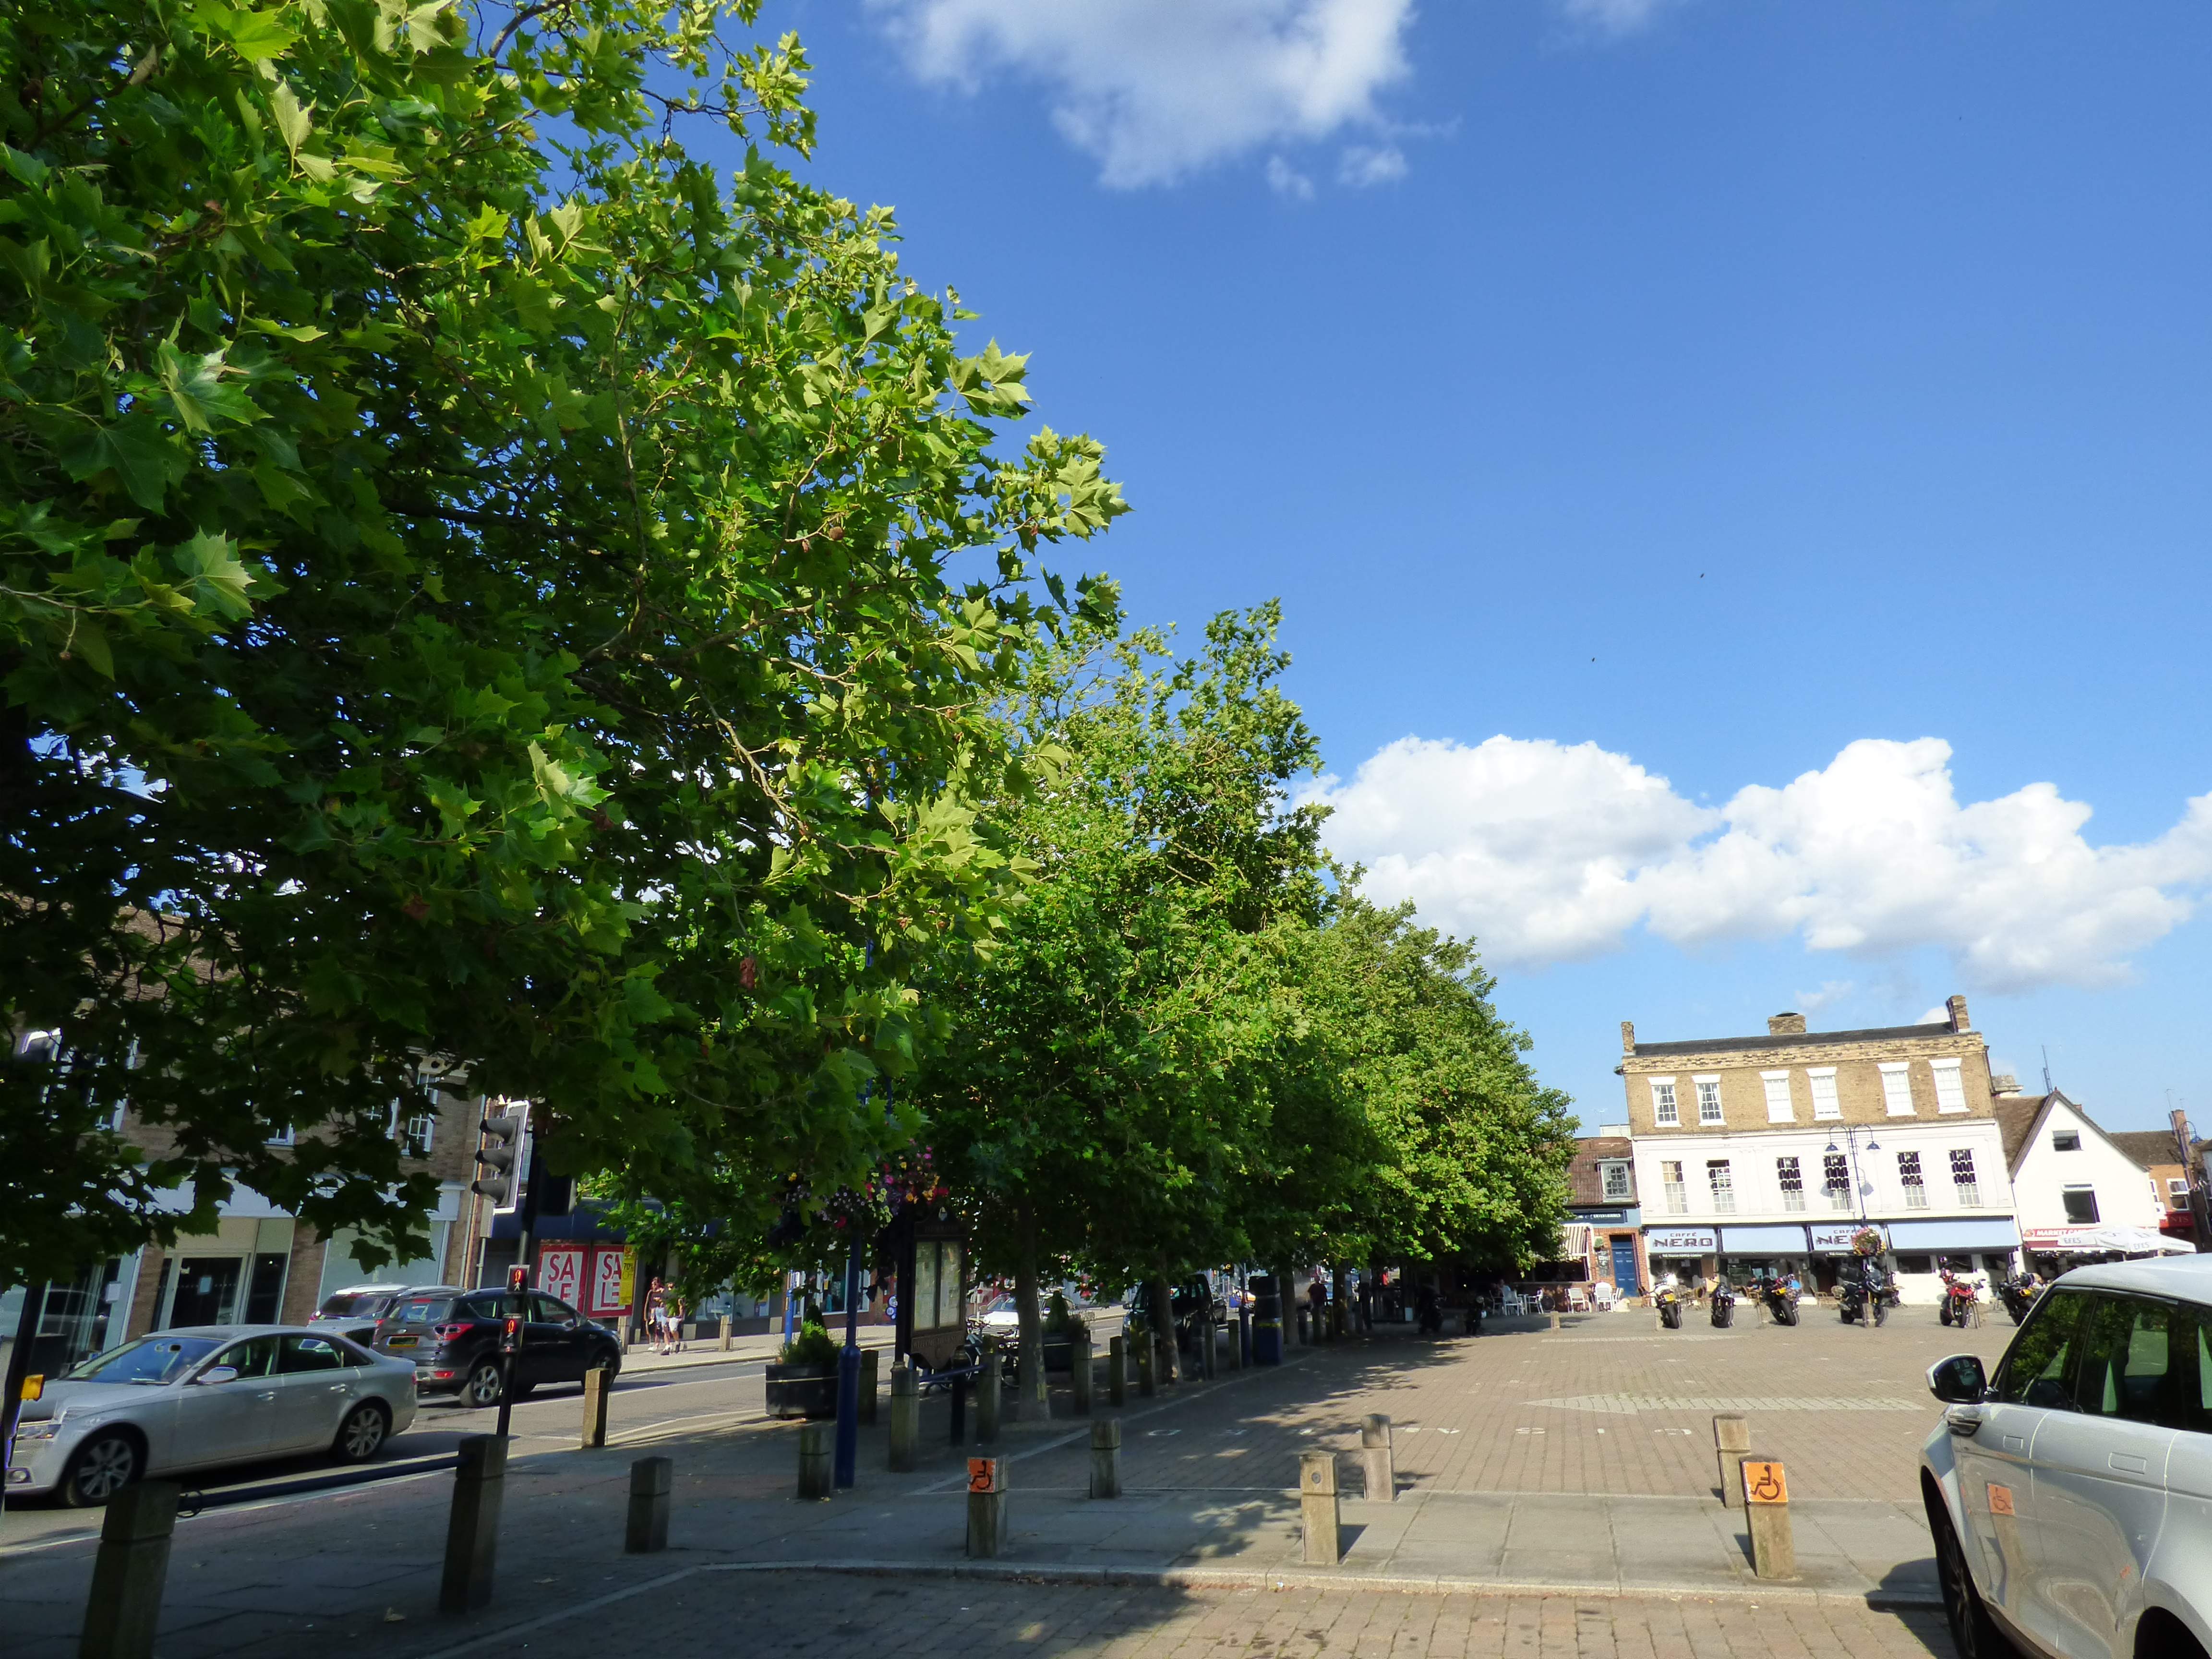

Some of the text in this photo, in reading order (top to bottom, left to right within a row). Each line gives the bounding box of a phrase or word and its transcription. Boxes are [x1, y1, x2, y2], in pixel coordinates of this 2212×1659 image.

[1653, 1238, 1713, 1247] NERO
[2133, 1242, 2150, 1250] EFES
[548, 1253, 575, 1282] SA
